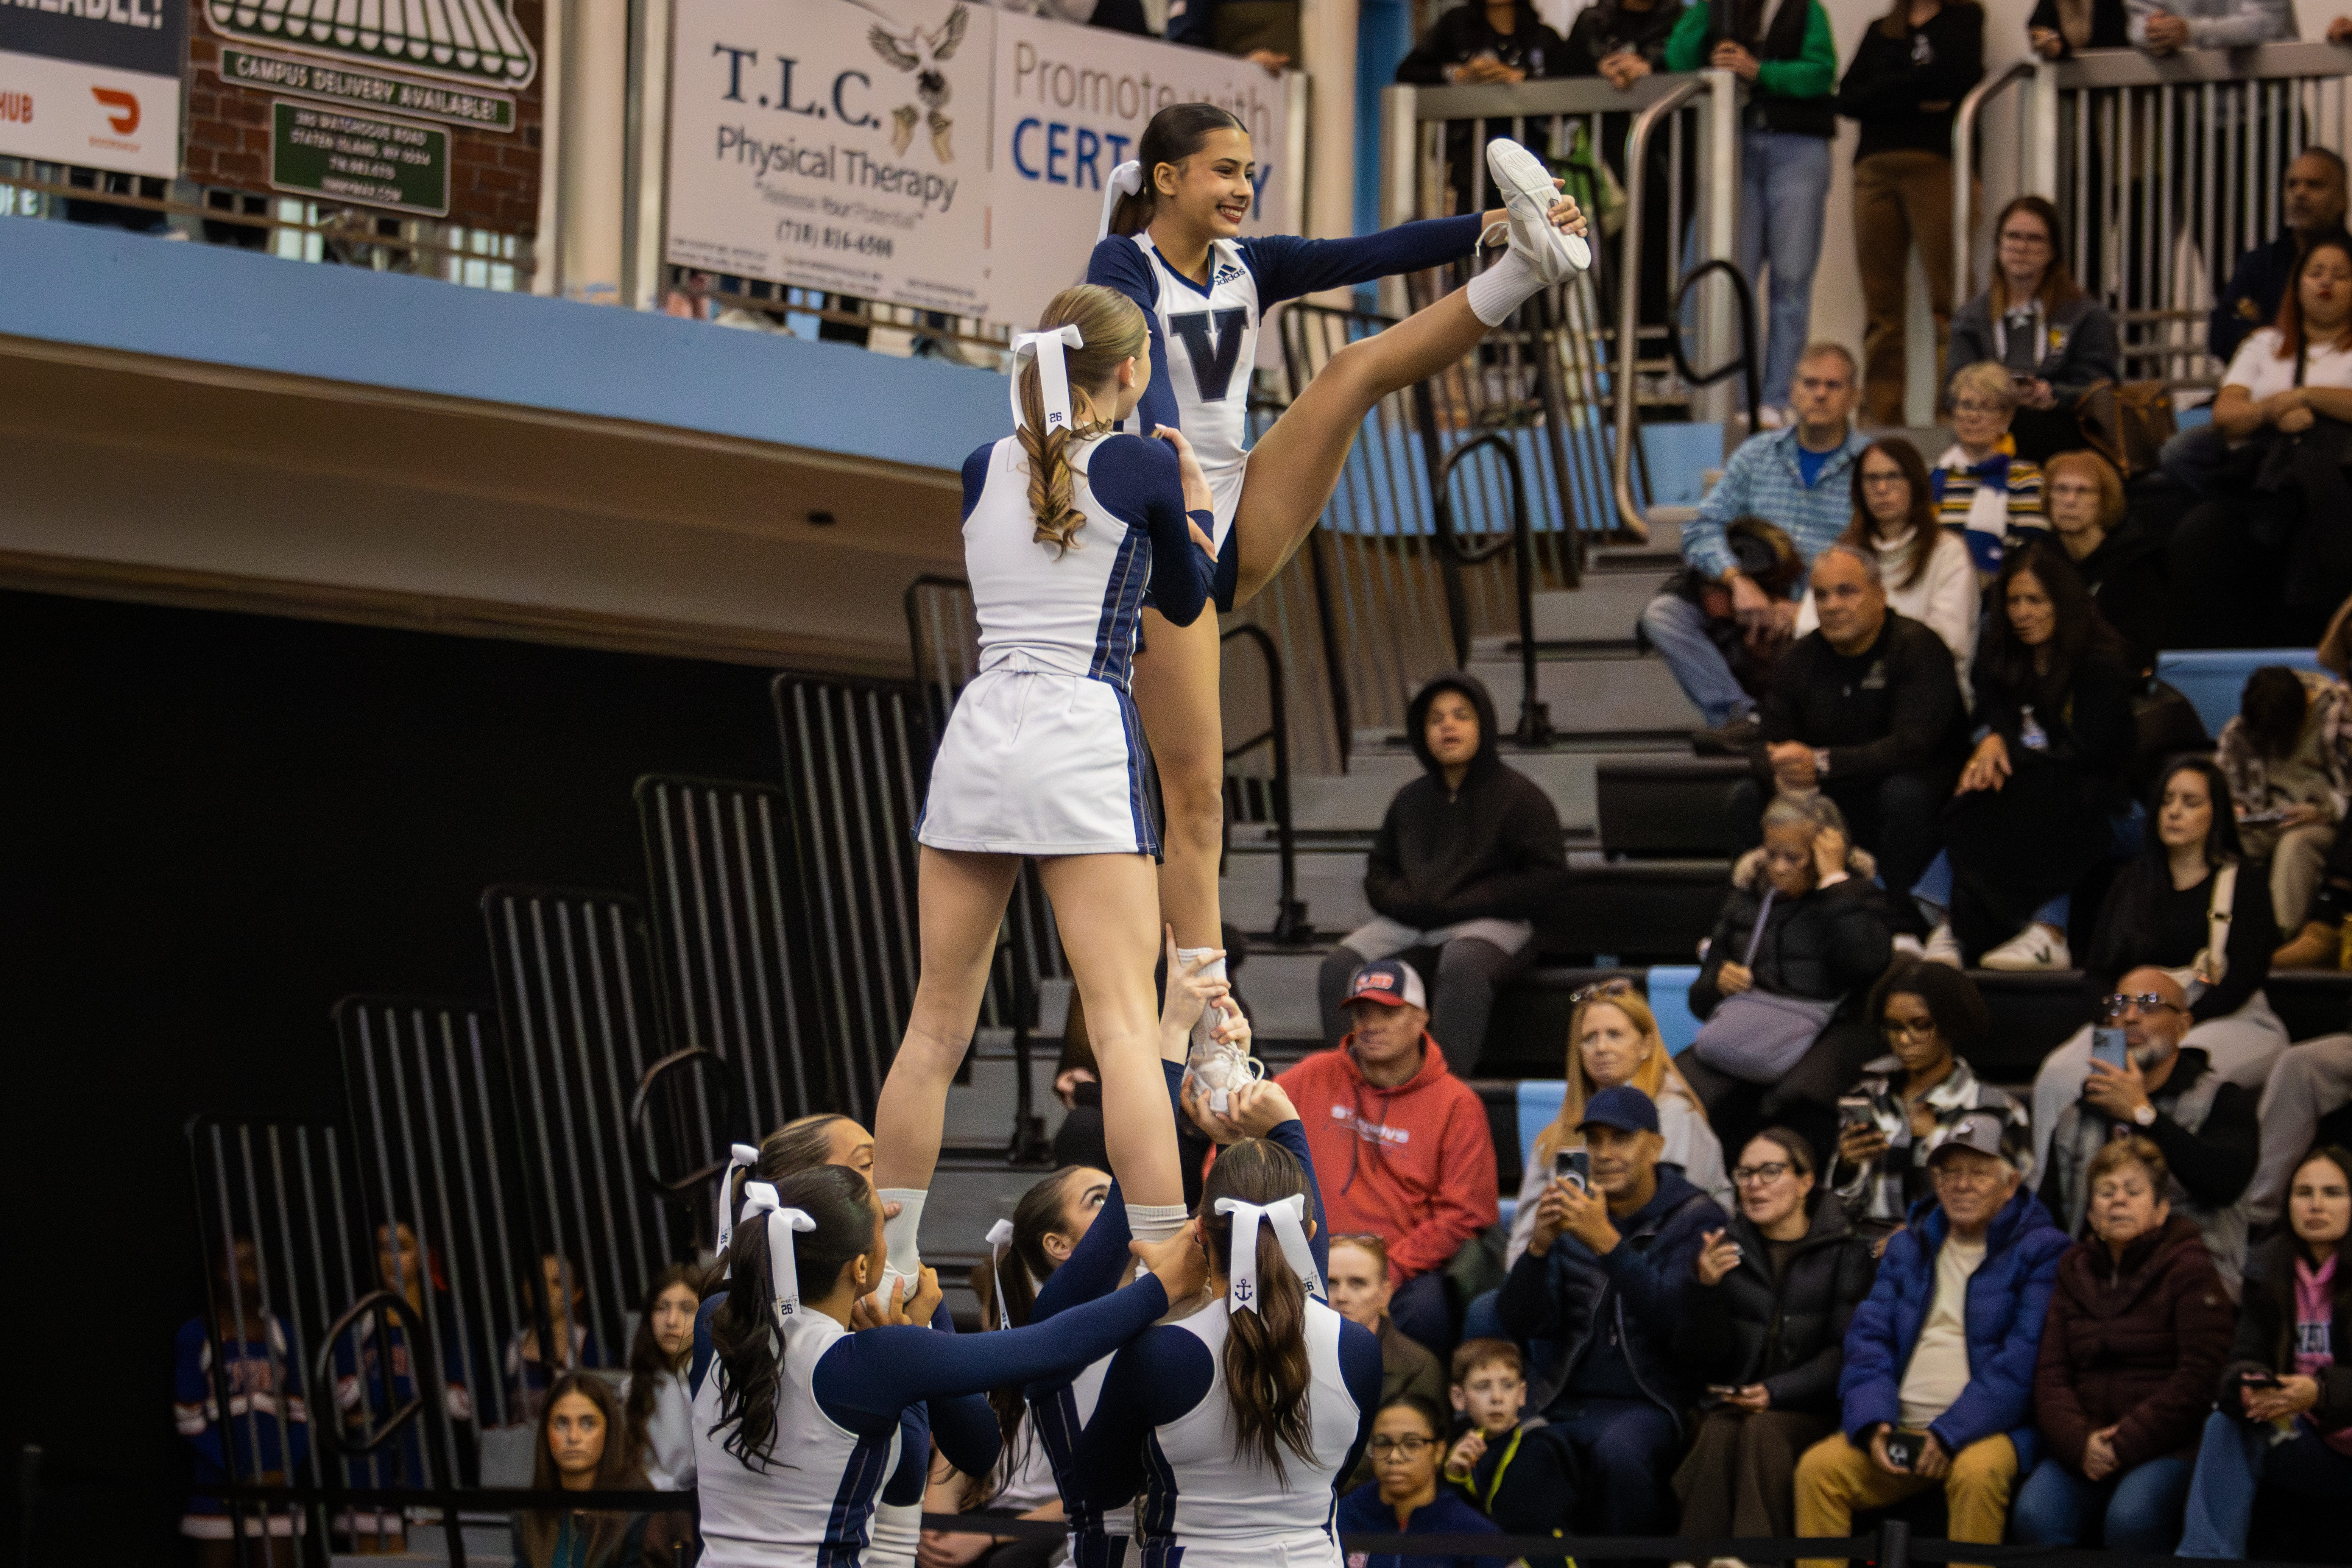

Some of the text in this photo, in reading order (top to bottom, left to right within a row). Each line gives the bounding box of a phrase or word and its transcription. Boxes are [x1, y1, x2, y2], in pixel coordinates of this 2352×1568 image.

[236, 55, 498, 122] CAMPUS DELIVERY AVAILABLE!
[713, 42, 881, 130] T.L.C.
[1013, 42, 1176, 120] Promote
[717, 124, 836, 183] Physical
[842, 150, 958, 213] Therapy
[1214, 267, 1245, 286] adidas
[1167, 305, 1250, 404] V
[1049, 411, 1062, 423] 26
[781, 1303, 793, 1315] 26
